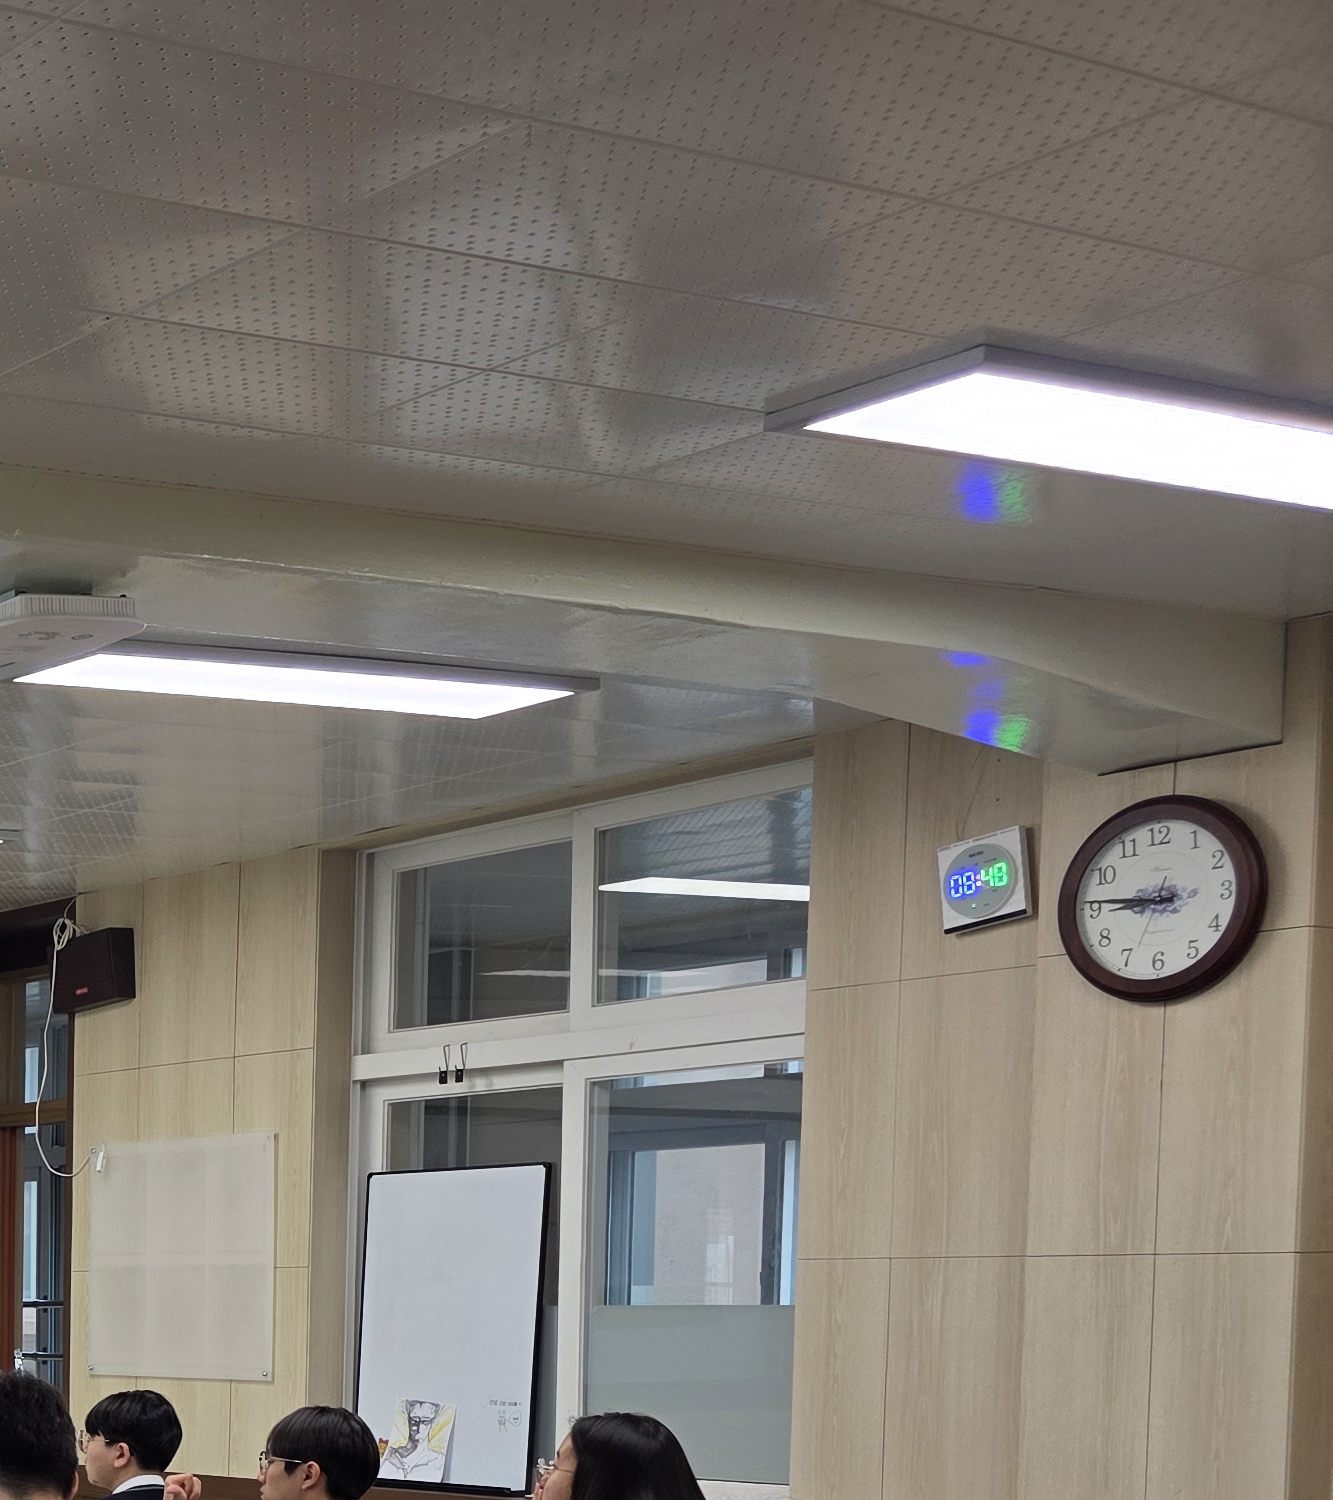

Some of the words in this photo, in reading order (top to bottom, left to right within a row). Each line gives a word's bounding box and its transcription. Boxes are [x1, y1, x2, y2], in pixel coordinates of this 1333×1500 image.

[1147, 825, 1171, 847] 12
[1190, 830, 1201, 849] 1
[1119, 838, 1140, 859] 11
[1211, 849, 1225, 870] 2
[950, 862, 1007, 898] 08:48
[1095, 865, 1116, 886] 10
[1219, 880, 1233, 900] 3
[1089, 900, 1102, 919] 9
[1207, 913, 1222, 932] 4
[1098, 928, 1111, 947] 8
[1120, 947, 1134, 968] 7
[1186, 939, 1200, 959] 5
[1152, 951, 1165, 971] 6
